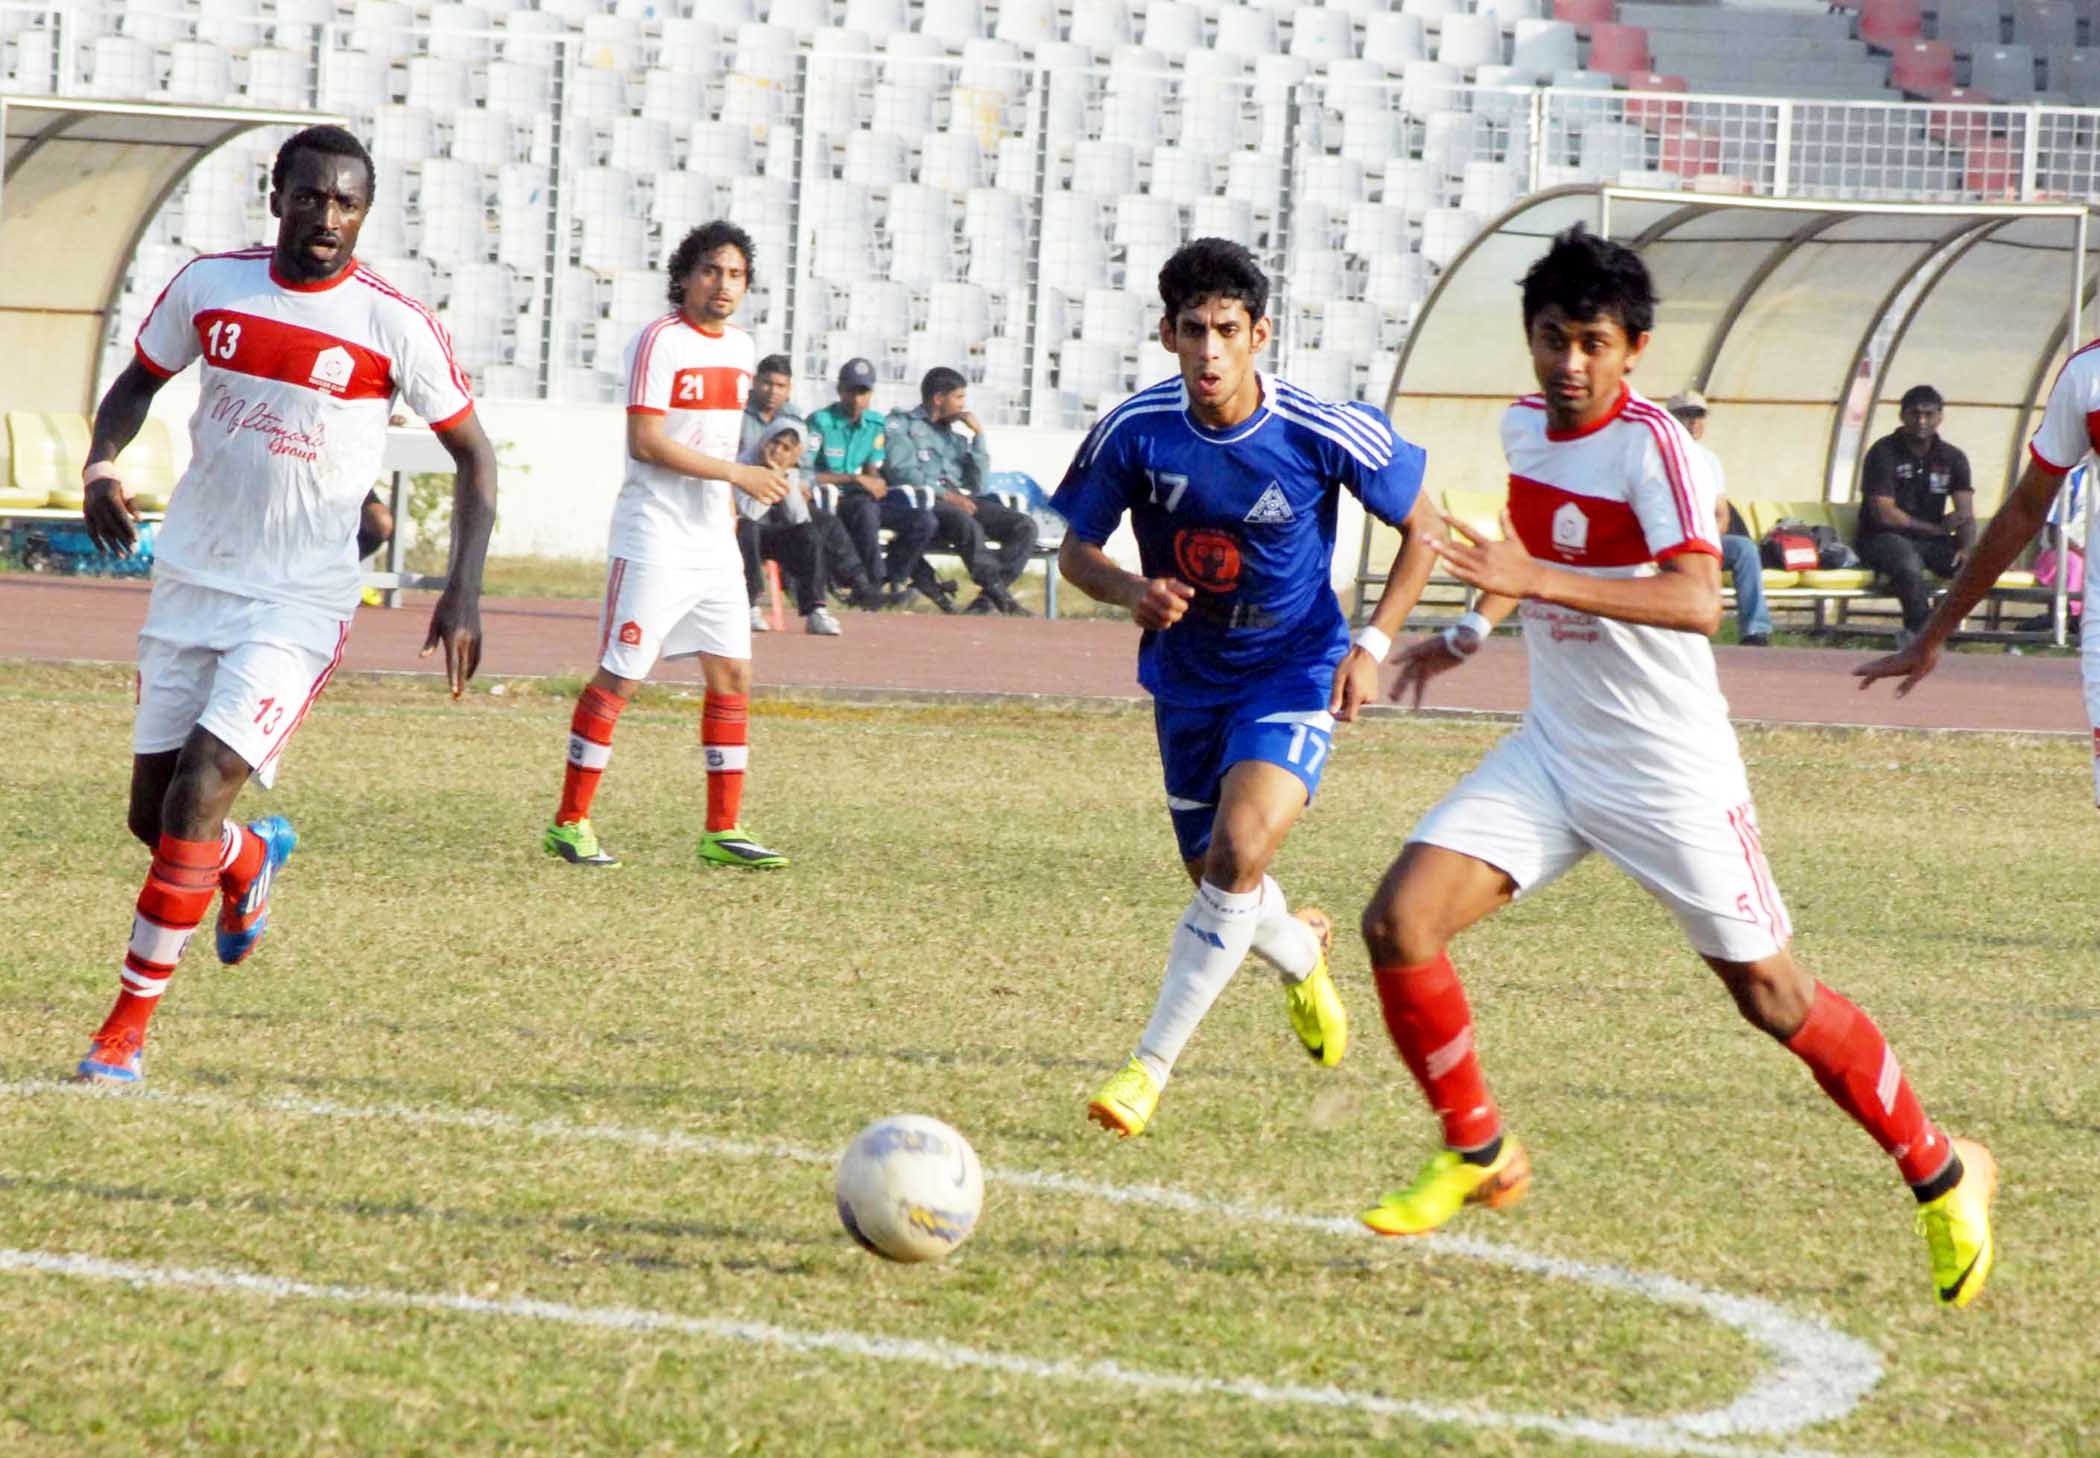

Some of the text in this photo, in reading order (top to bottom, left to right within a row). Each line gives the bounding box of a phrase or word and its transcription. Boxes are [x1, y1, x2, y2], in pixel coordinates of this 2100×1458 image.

[207, 320, 241, 360] 13
[679, 373, 704, 400] 21
[268, 438, 317, 463] Group
[1144, 468, 1189, 513] 17
[253, 697, 284, 735] 13
[1287, 722, 1326, 776] 17
[1736, 893, 1759, 925] 5
